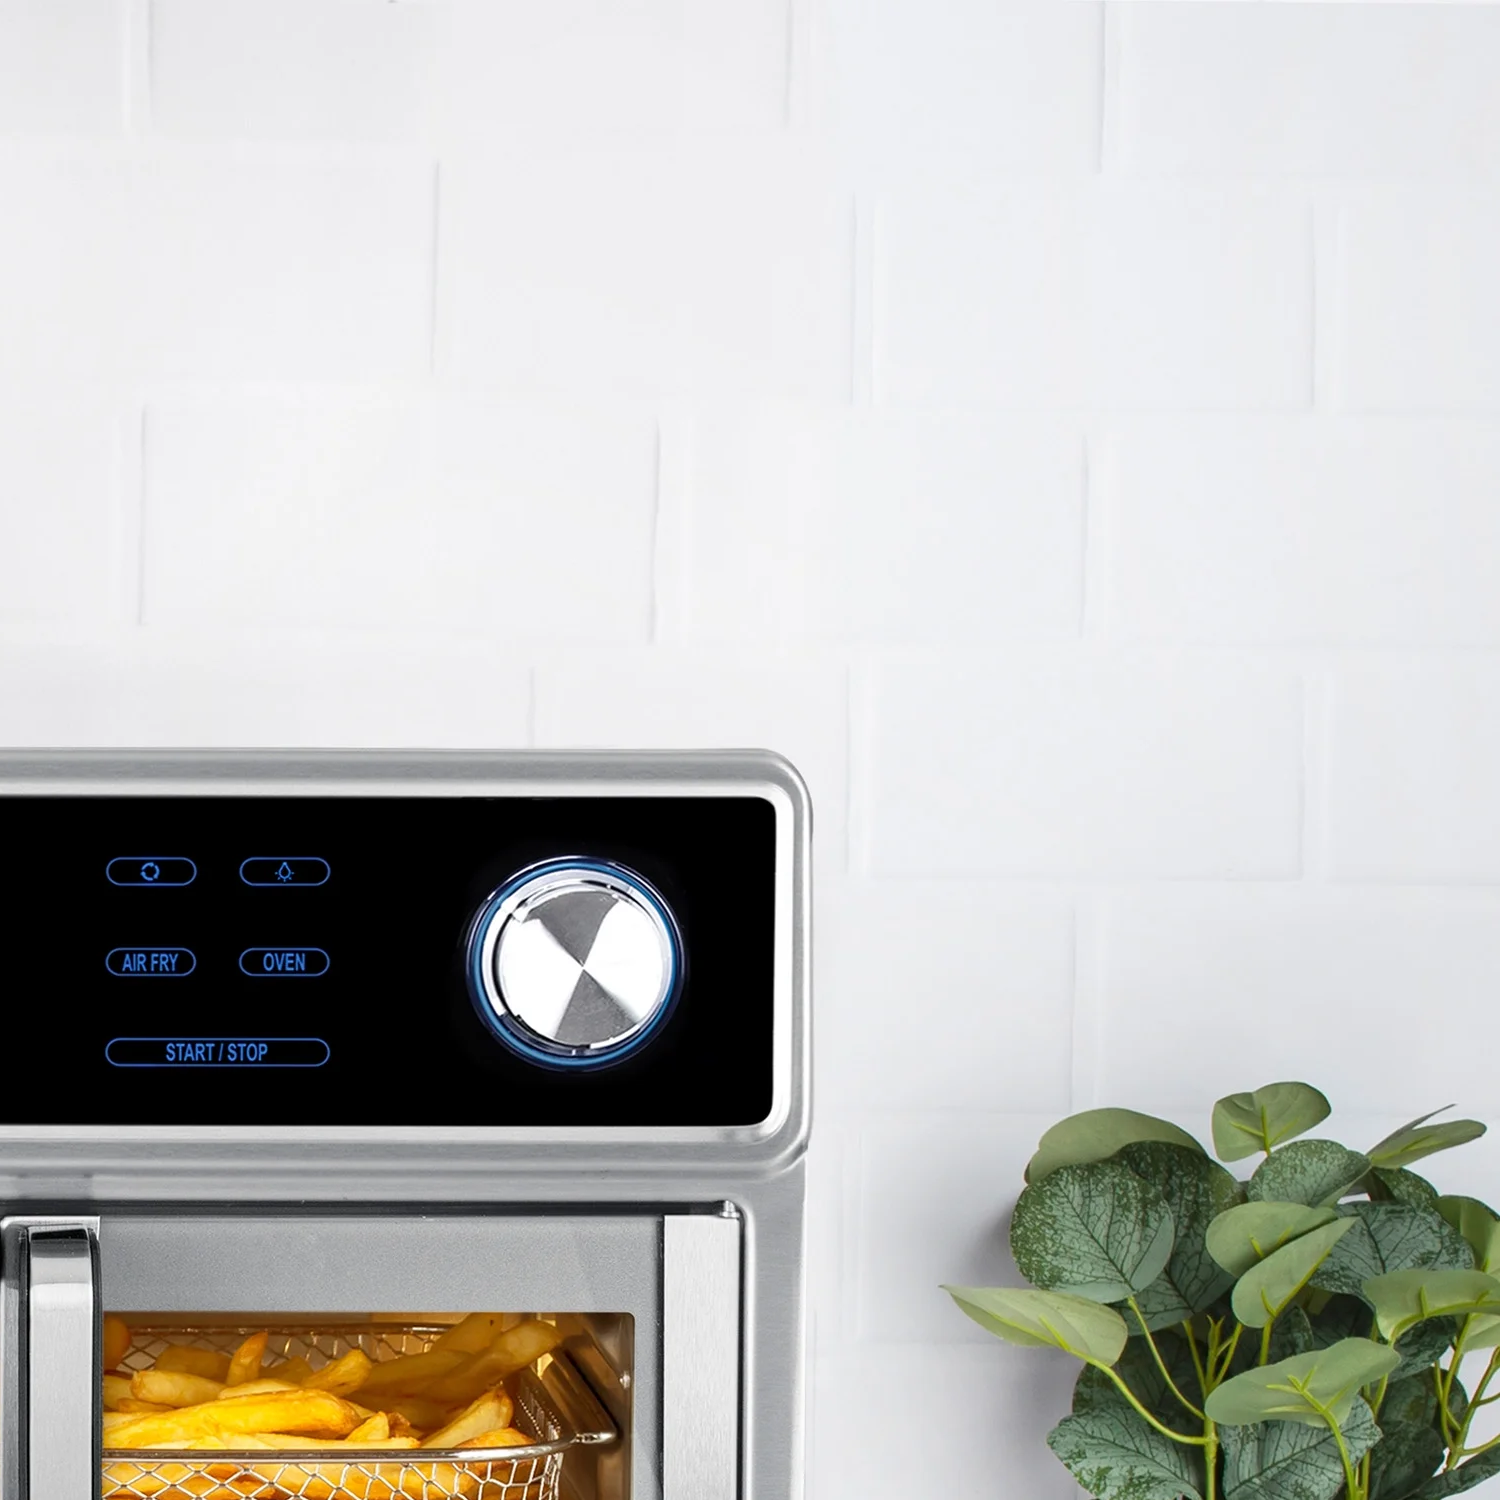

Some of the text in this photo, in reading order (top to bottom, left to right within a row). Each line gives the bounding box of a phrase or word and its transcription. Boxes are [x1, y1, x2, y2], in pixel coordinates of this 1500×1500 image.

[122, 953, 179, 972] AIR FRY
[263, 952, 306, 972] OVEN
[165, 1042, 215, 1062] START
[227, 1042, 268, 1062] STOP
